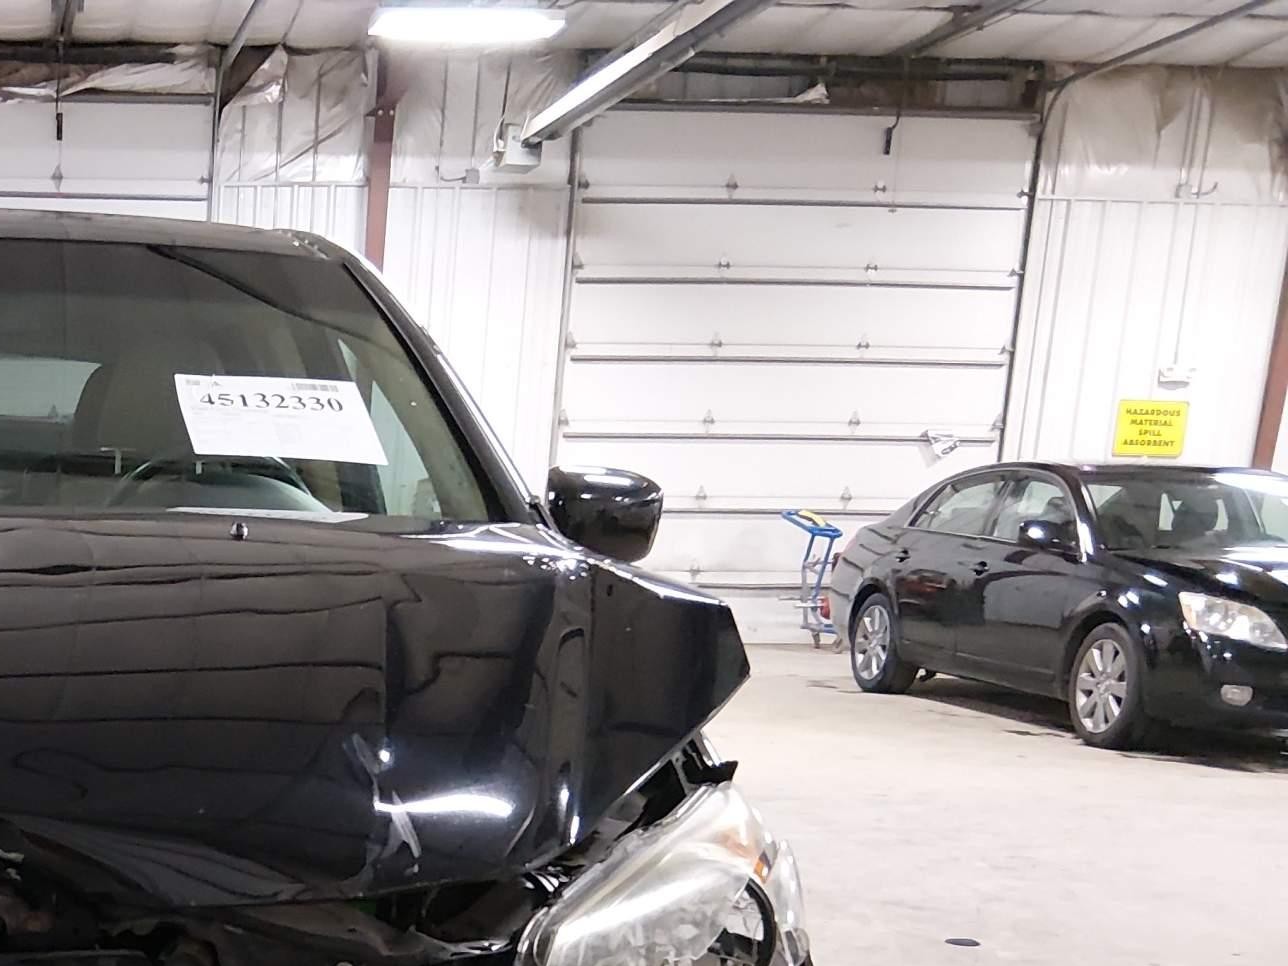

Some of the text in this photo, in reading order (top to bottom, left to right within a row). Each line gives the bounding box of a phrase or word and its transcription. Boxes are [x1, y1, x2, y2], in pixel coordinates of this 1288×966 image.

[199, 392, 344, 412] 45132330
[1126, 408, 1181, 417] HAZARDOUS
[1130, 418, 1173, 427] MATERIAL
[1138, 428, 1162, 437] SPILL
[1122, 439, 1175, 447] ABSORBENT
